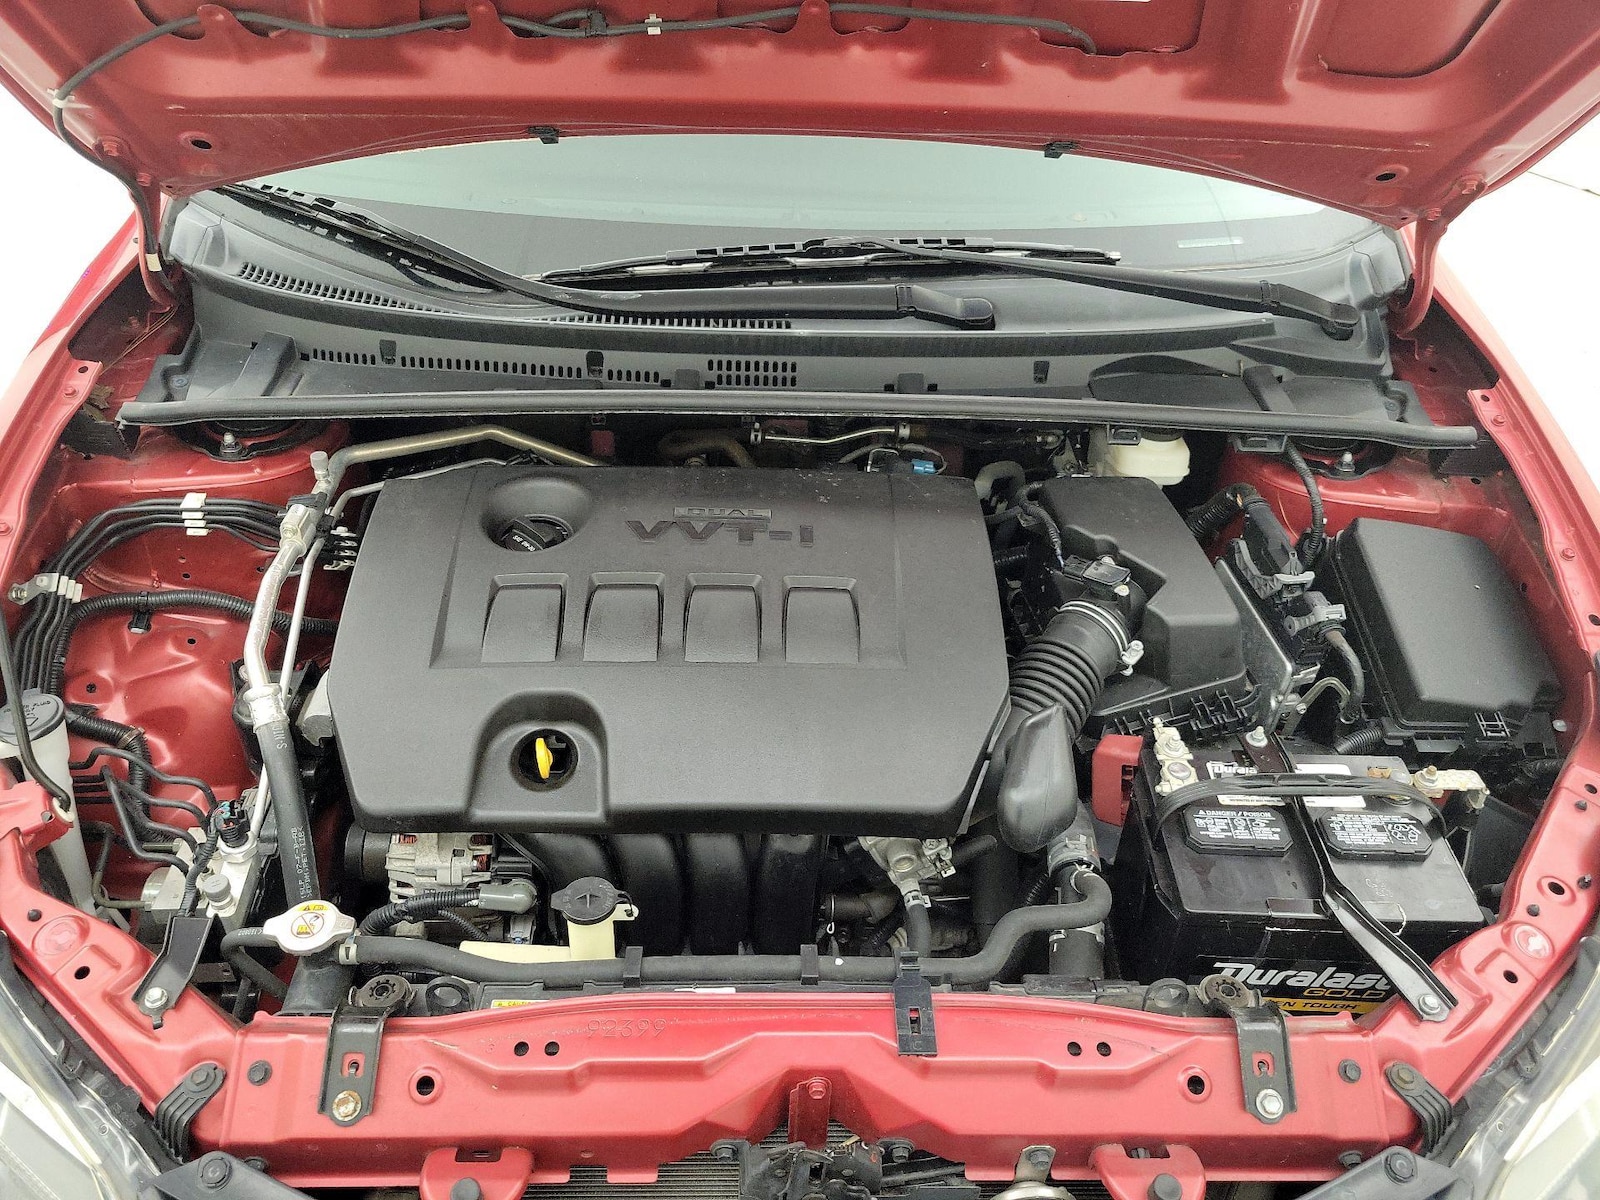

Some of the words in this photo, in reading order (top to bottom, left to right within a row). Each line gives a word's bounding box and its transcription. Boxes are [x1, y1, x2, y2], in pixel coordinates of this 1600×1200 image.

[686, 507, 763, 517] DUAL
[1303, 988, 1386, 999] GOLD
[1302, 1002, 1359, 1010] TOUGH
[587, 1018, 667, 1038] 92399
